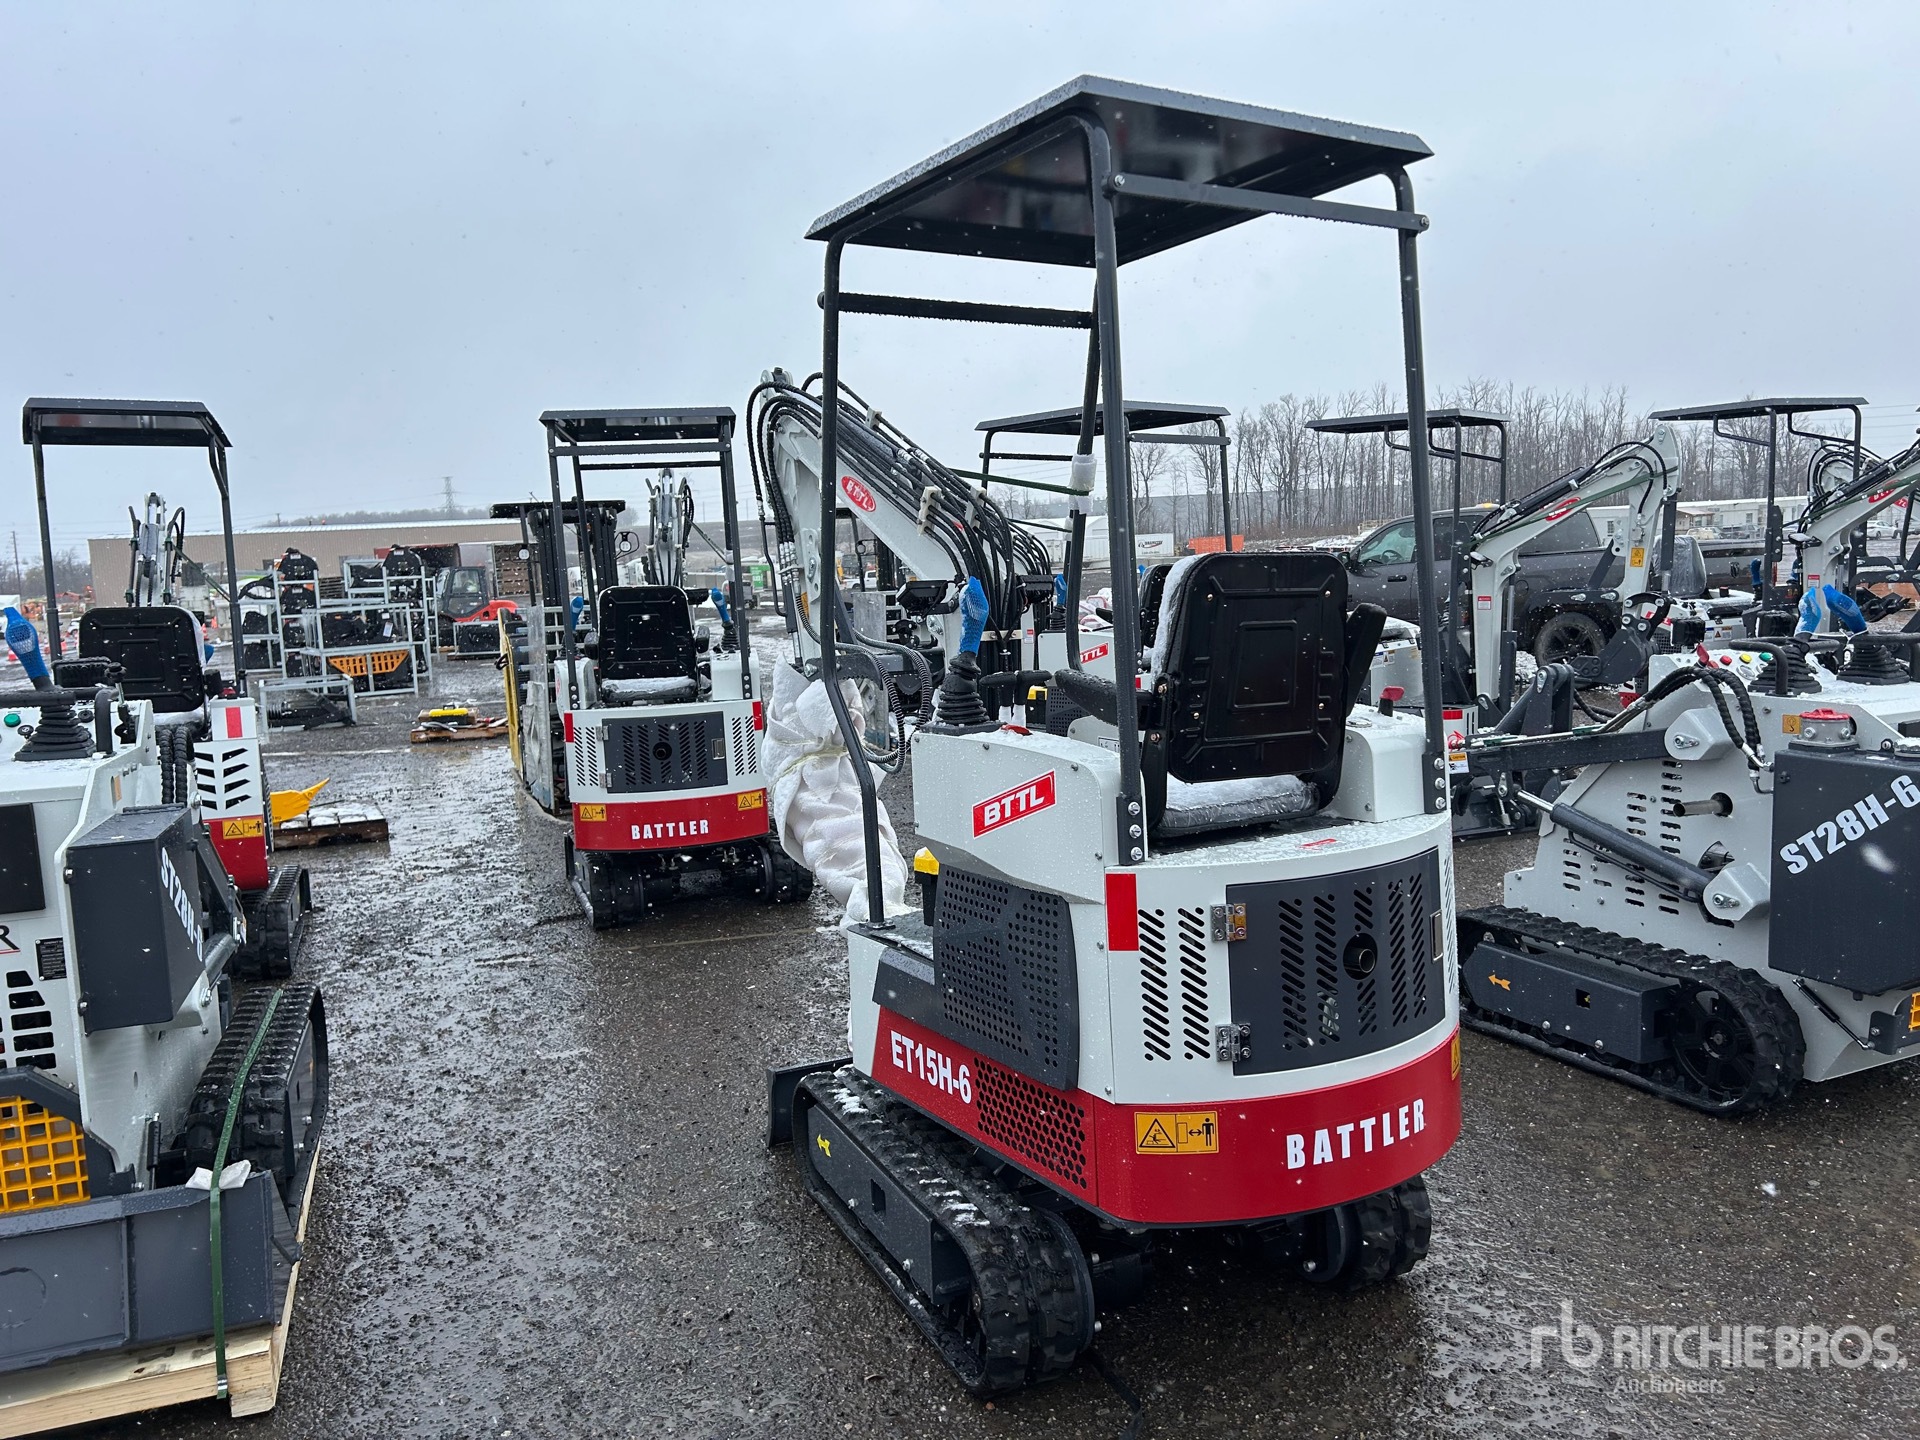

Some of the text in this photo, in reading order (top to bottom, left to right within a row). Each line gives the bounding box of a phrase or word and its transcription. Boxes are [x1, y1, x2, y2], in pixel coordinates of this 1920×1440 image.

[846, 480, 868, 508] BTTL
[631, 819, 709, 840] BATTLER
[984, 784, 1045, 827] BTTL
[1779, 774, 1920, 874] ST28H-6
[891, 1029, 972, 1104] ET15H-6
[1286, 1098, 1425, 1170] BATTLER
